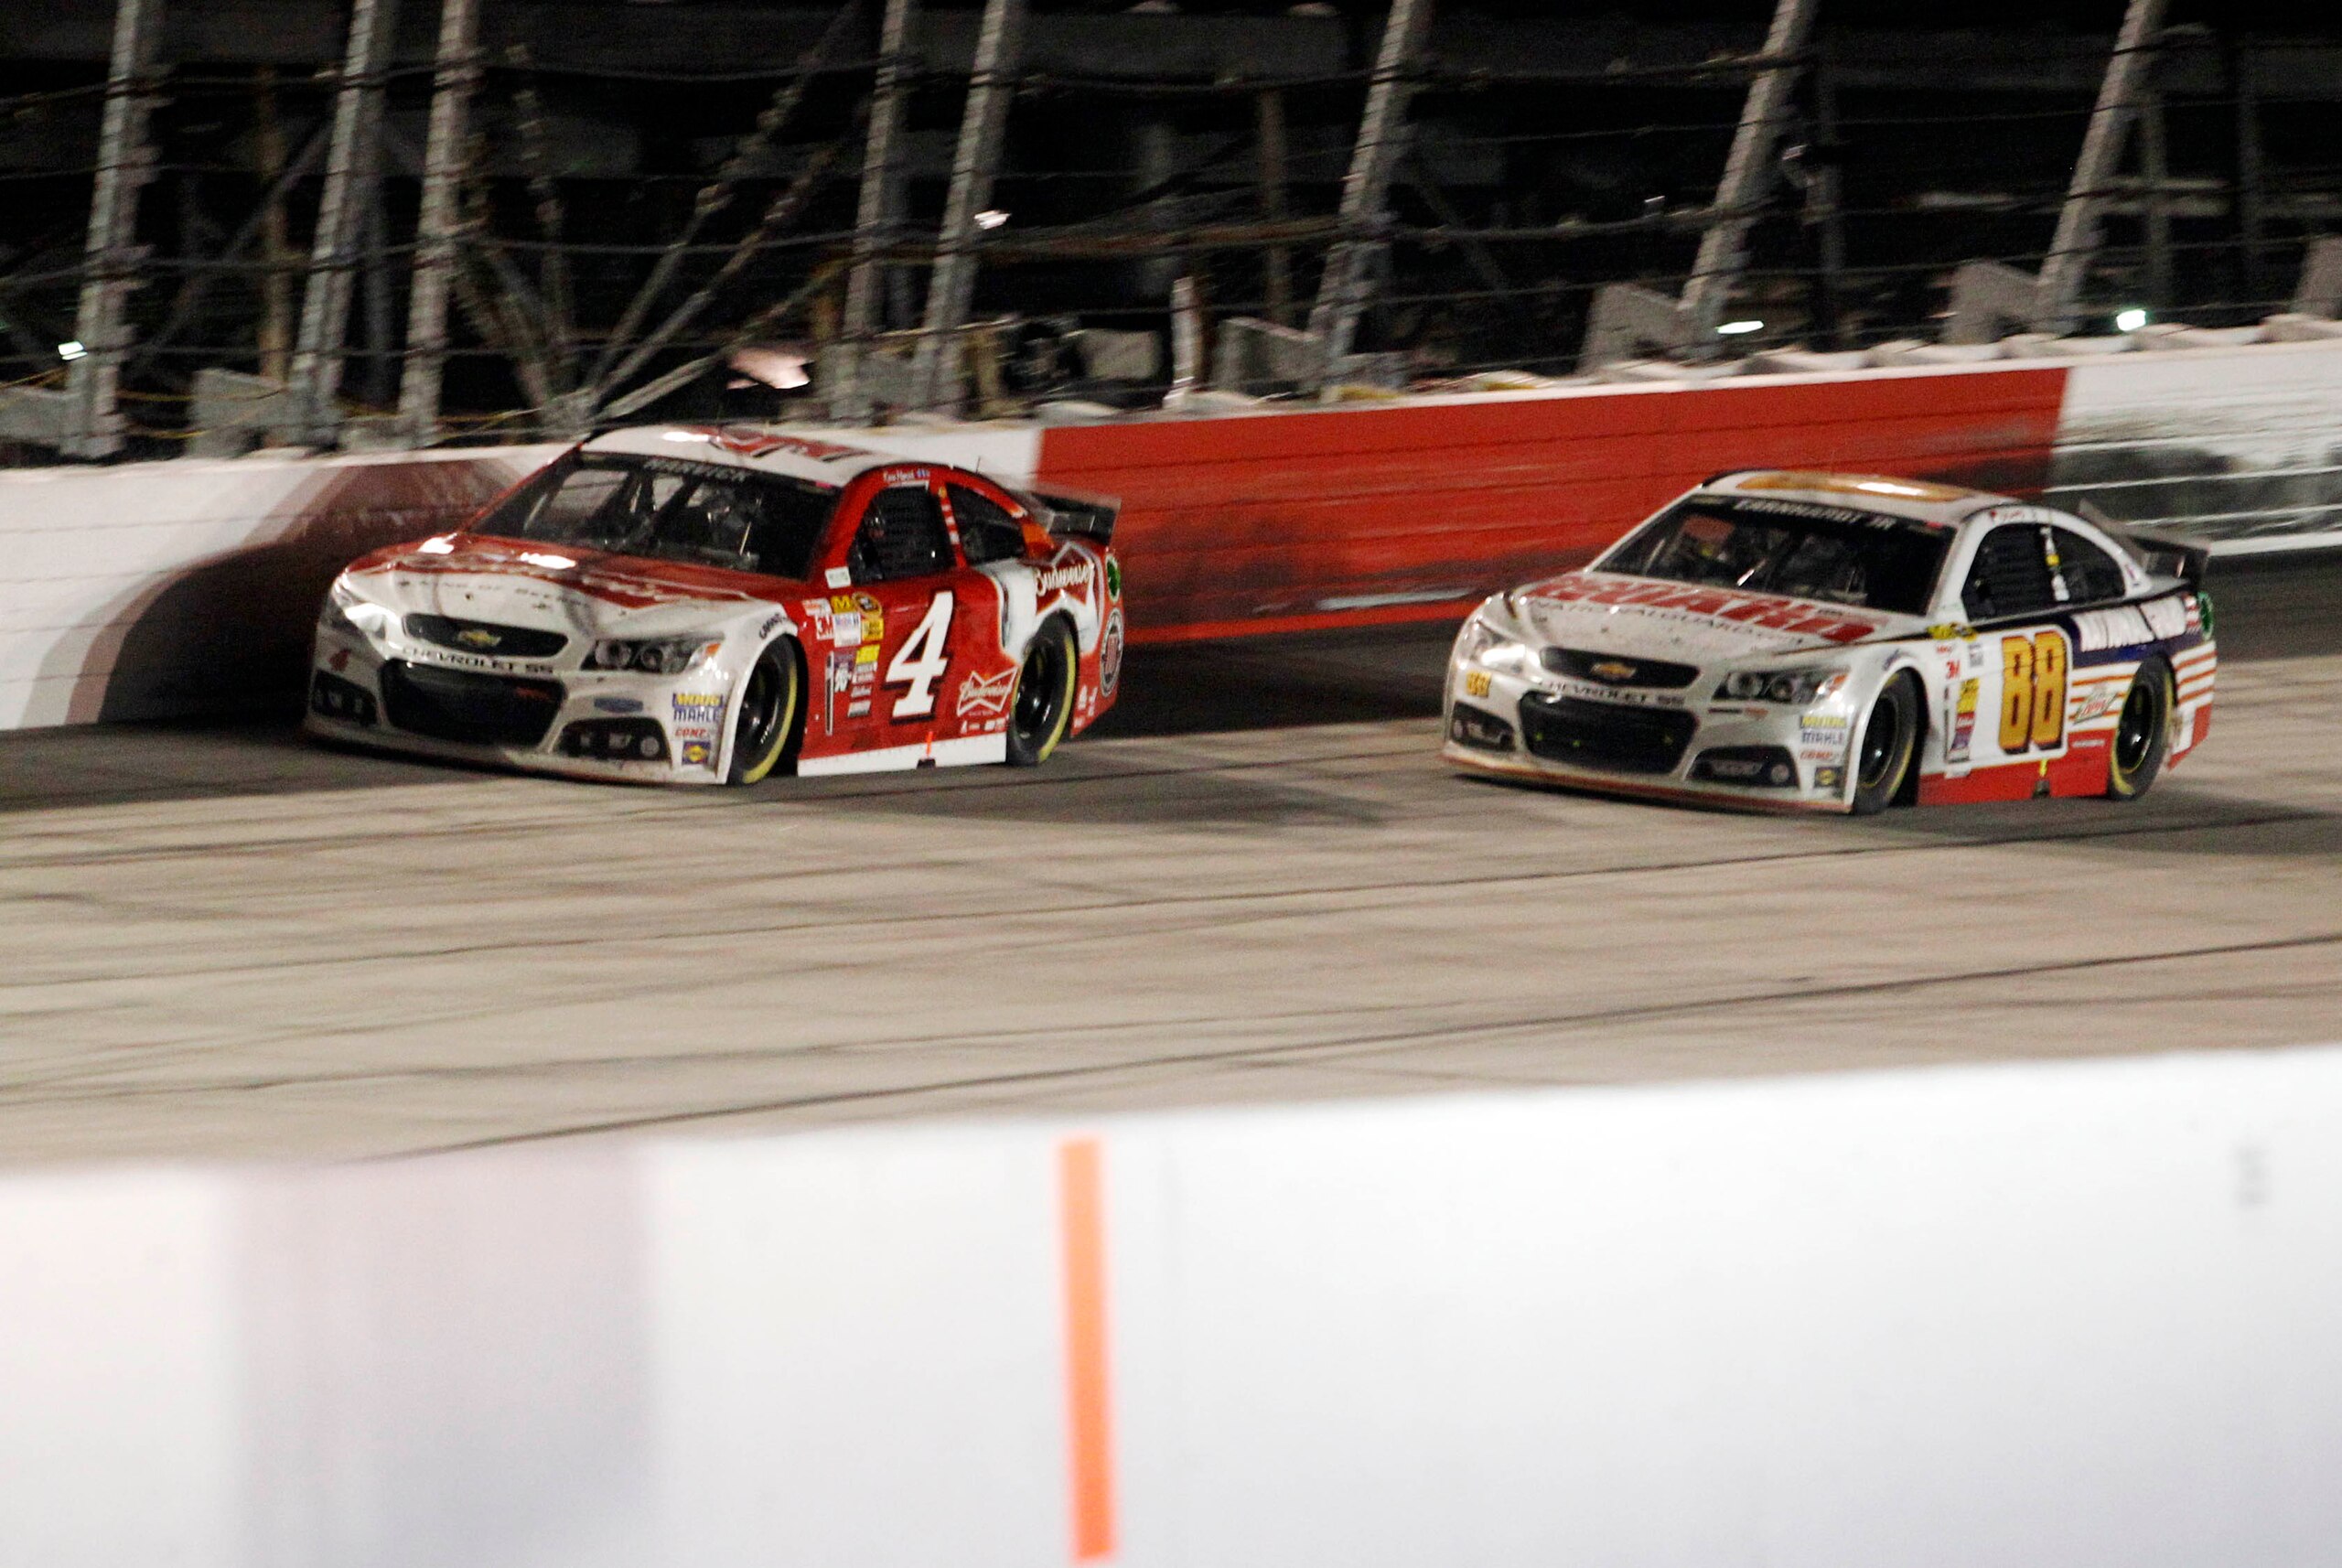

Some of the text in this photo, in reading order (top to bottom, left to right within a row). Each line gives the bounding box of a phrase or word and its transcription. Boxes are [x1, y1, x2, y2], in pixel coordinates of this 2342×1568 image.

[402, 646, 516, 671] CHEVROLET
[885, 591, 953, 717] 4
[1998, 629, 2068, 755] 88
